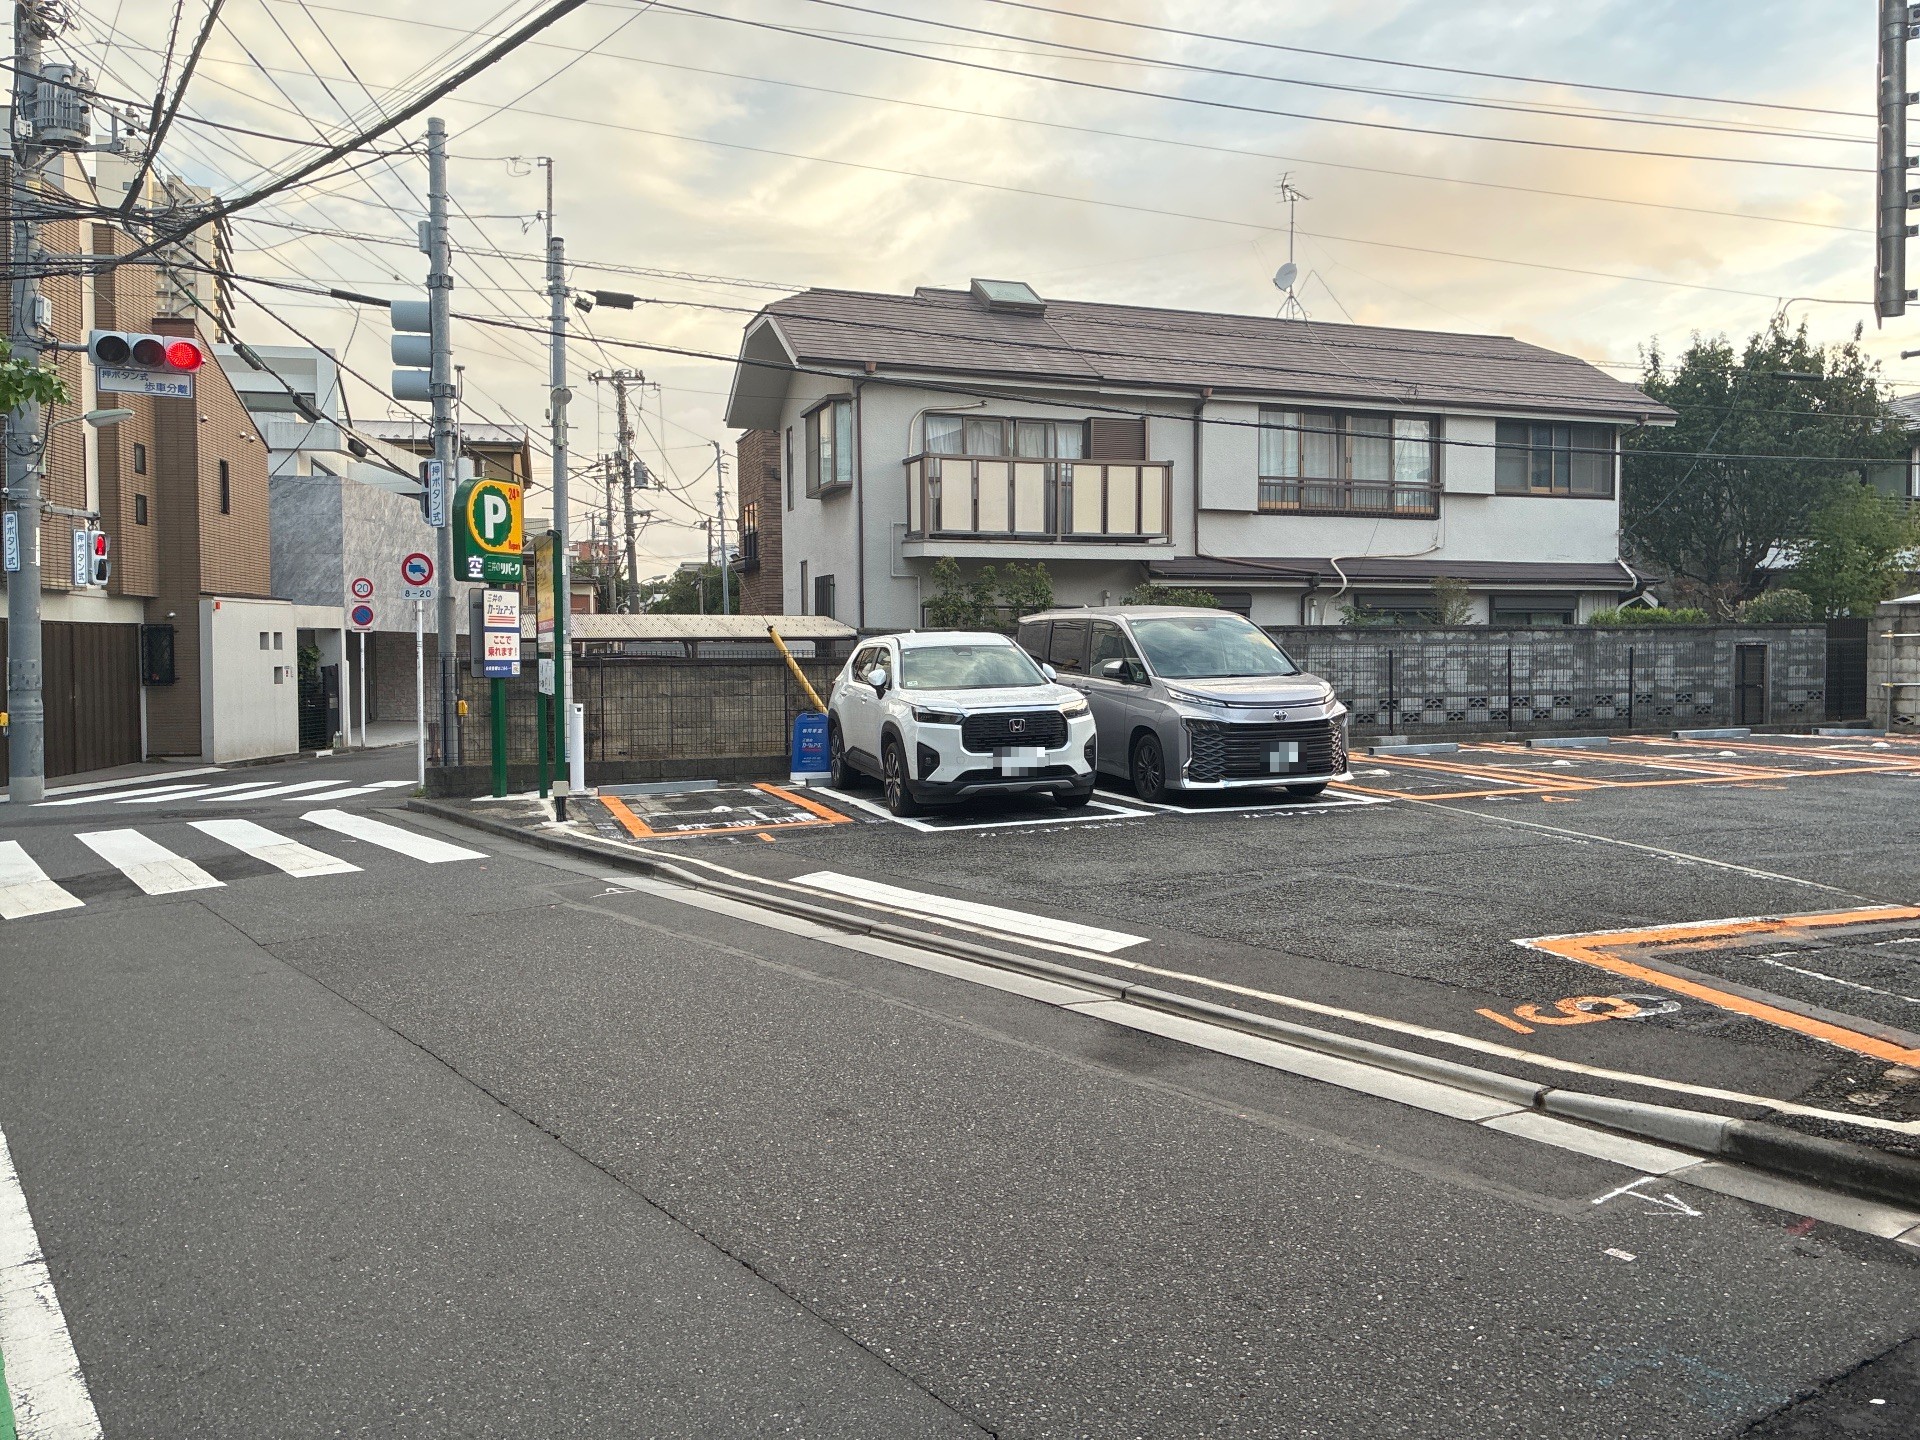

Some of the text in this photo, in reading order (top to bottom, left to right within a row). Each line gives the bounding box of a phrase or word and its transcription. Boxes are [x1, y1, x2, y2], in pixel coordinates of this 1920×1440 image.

[102, 370, 148, 381] 押ボタン式
[145, 382, 188, 394] 歩車分離
[432, 465, 441, 522] 押ボタン式
[484, 494, 507, 539] P
[6, 516, 16, 566] 押ボタン式
[77, 534, 85, 581] 押ボタン式
[467, 555, 484, 578] 空
[356, 583, 369, 593] 20
[405, 589, 432, 597] 8-20
[487, 593, 503, 602] 三井の
[487, 604, 516, 615] カーシェアーズ
[493, 635, 512, 645] ここで
